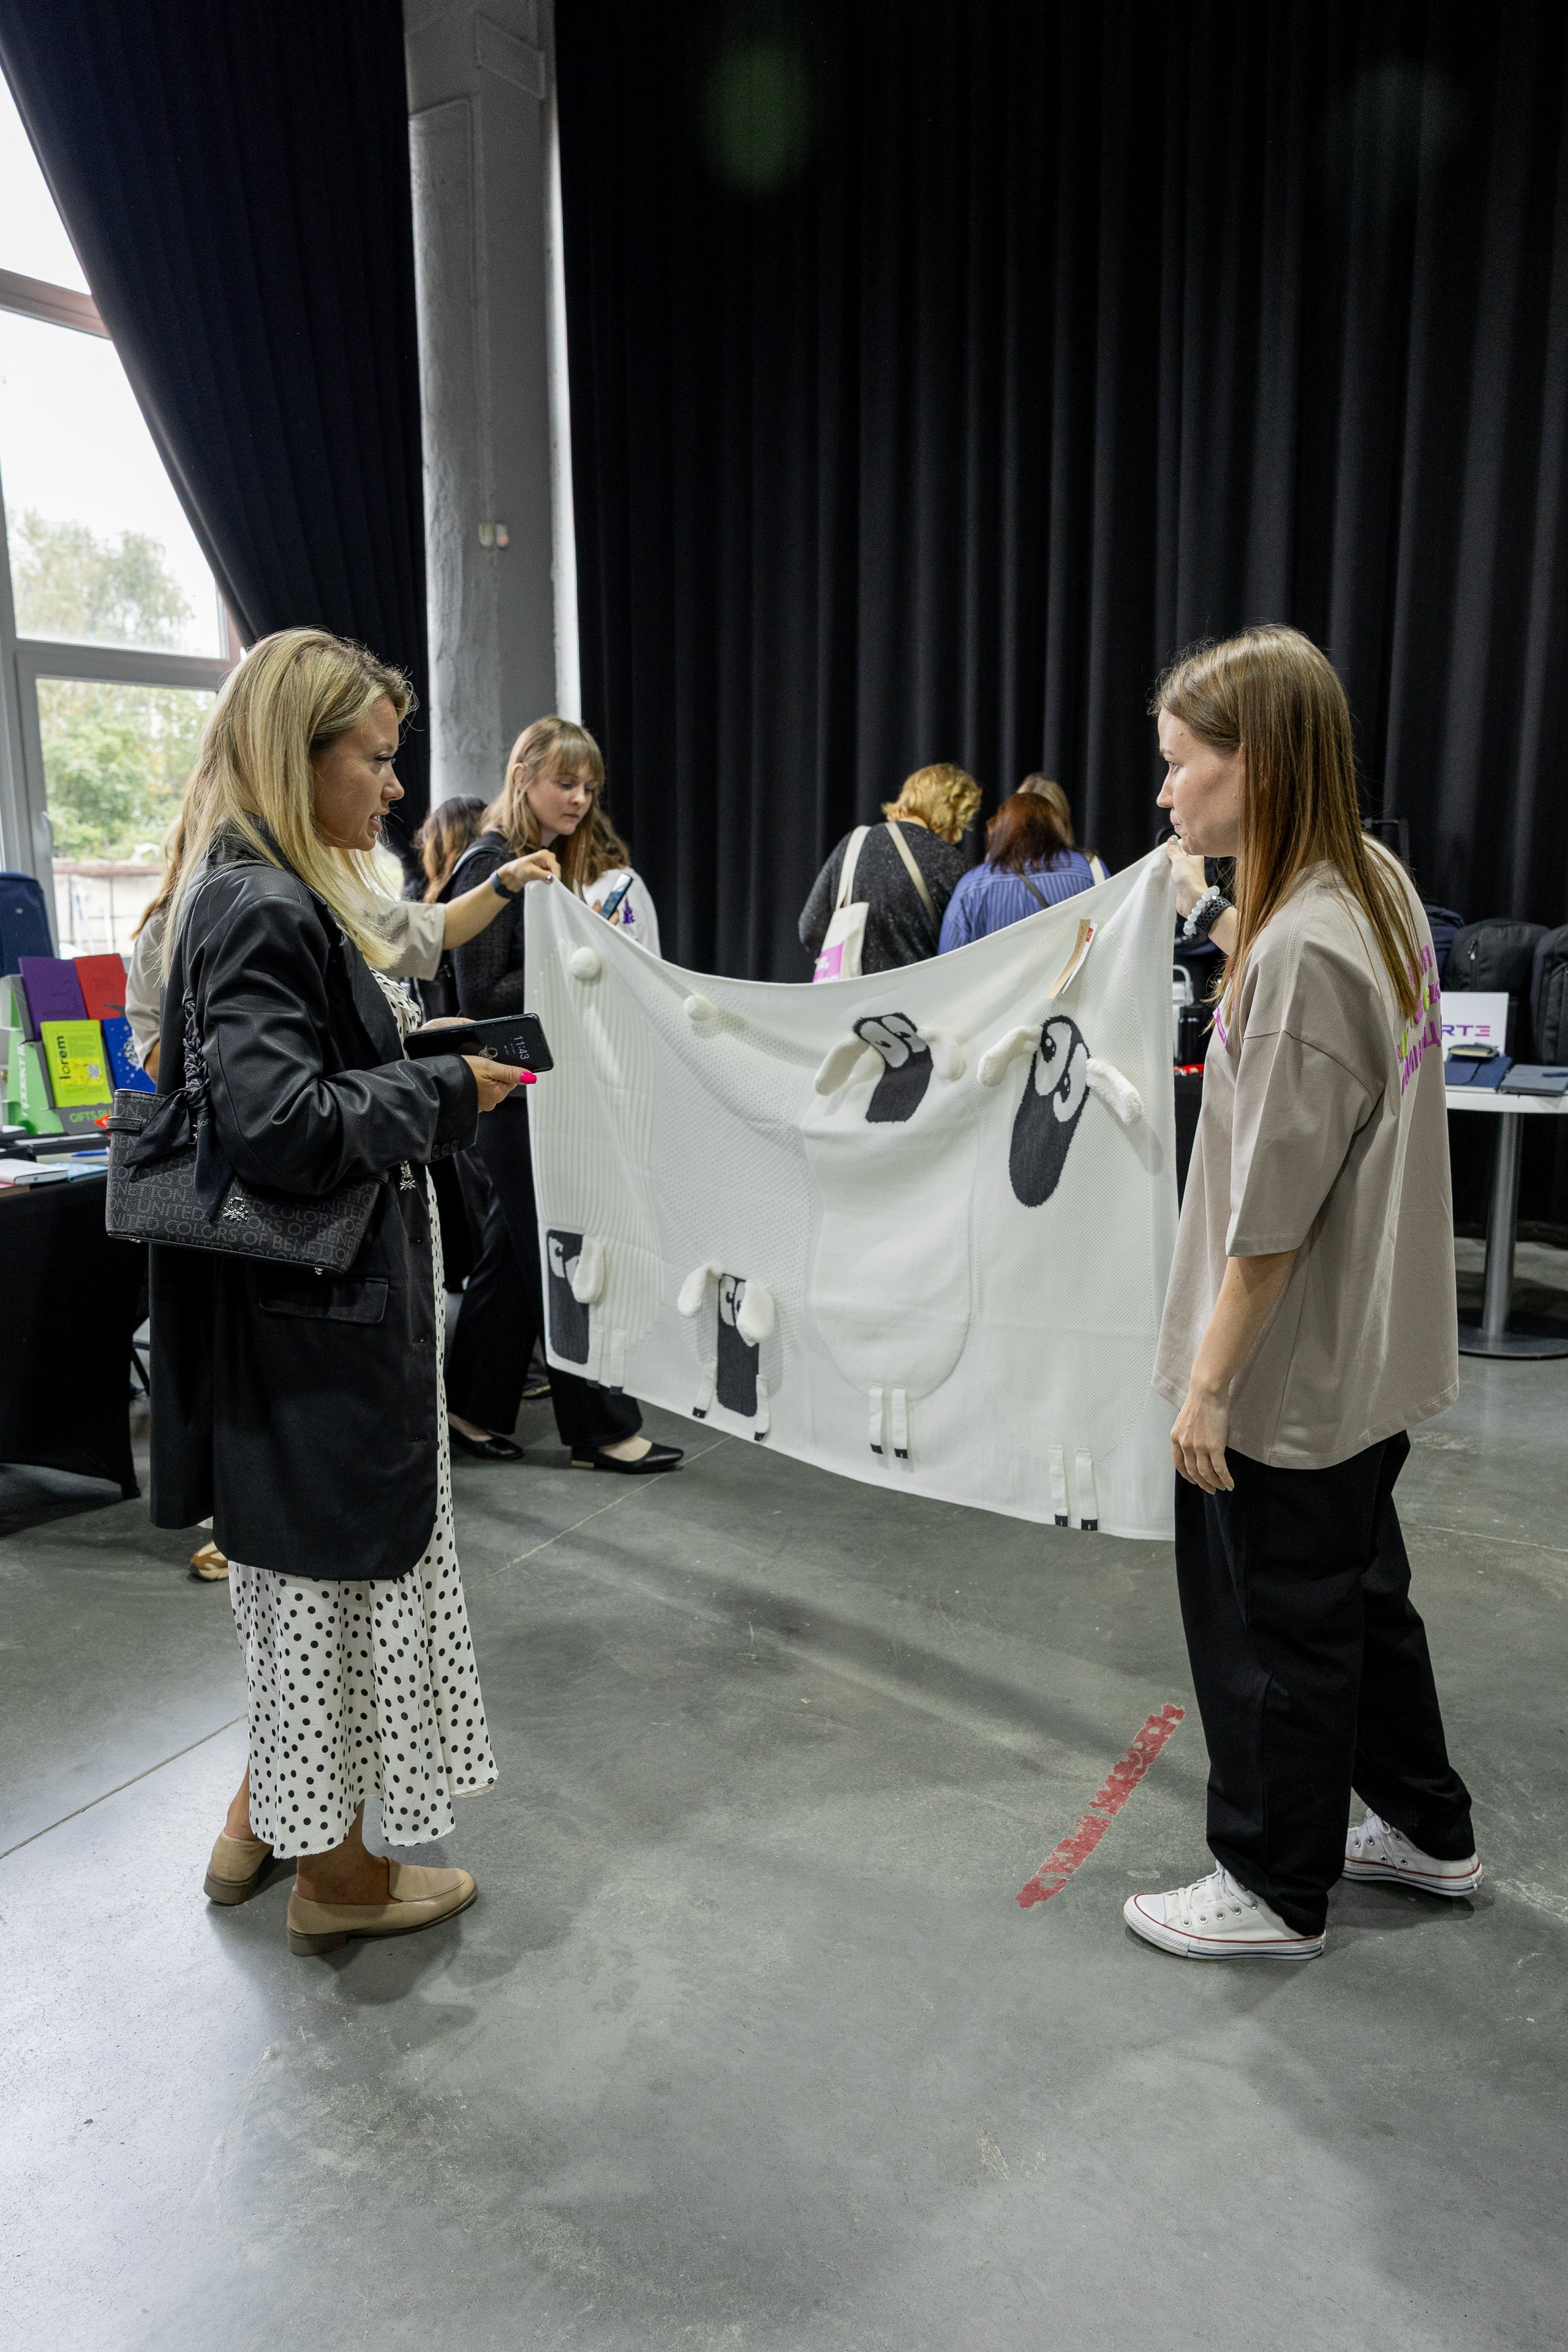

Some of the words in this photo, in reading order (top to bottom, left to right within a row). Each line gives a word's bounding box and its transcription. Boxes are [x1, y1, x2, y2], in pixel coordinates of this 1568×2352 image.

[57, 1036, 70, 1079] lorem
[514, 1036, 530, 1060] 11:43
[243, 1231, 268, 1246] OF
